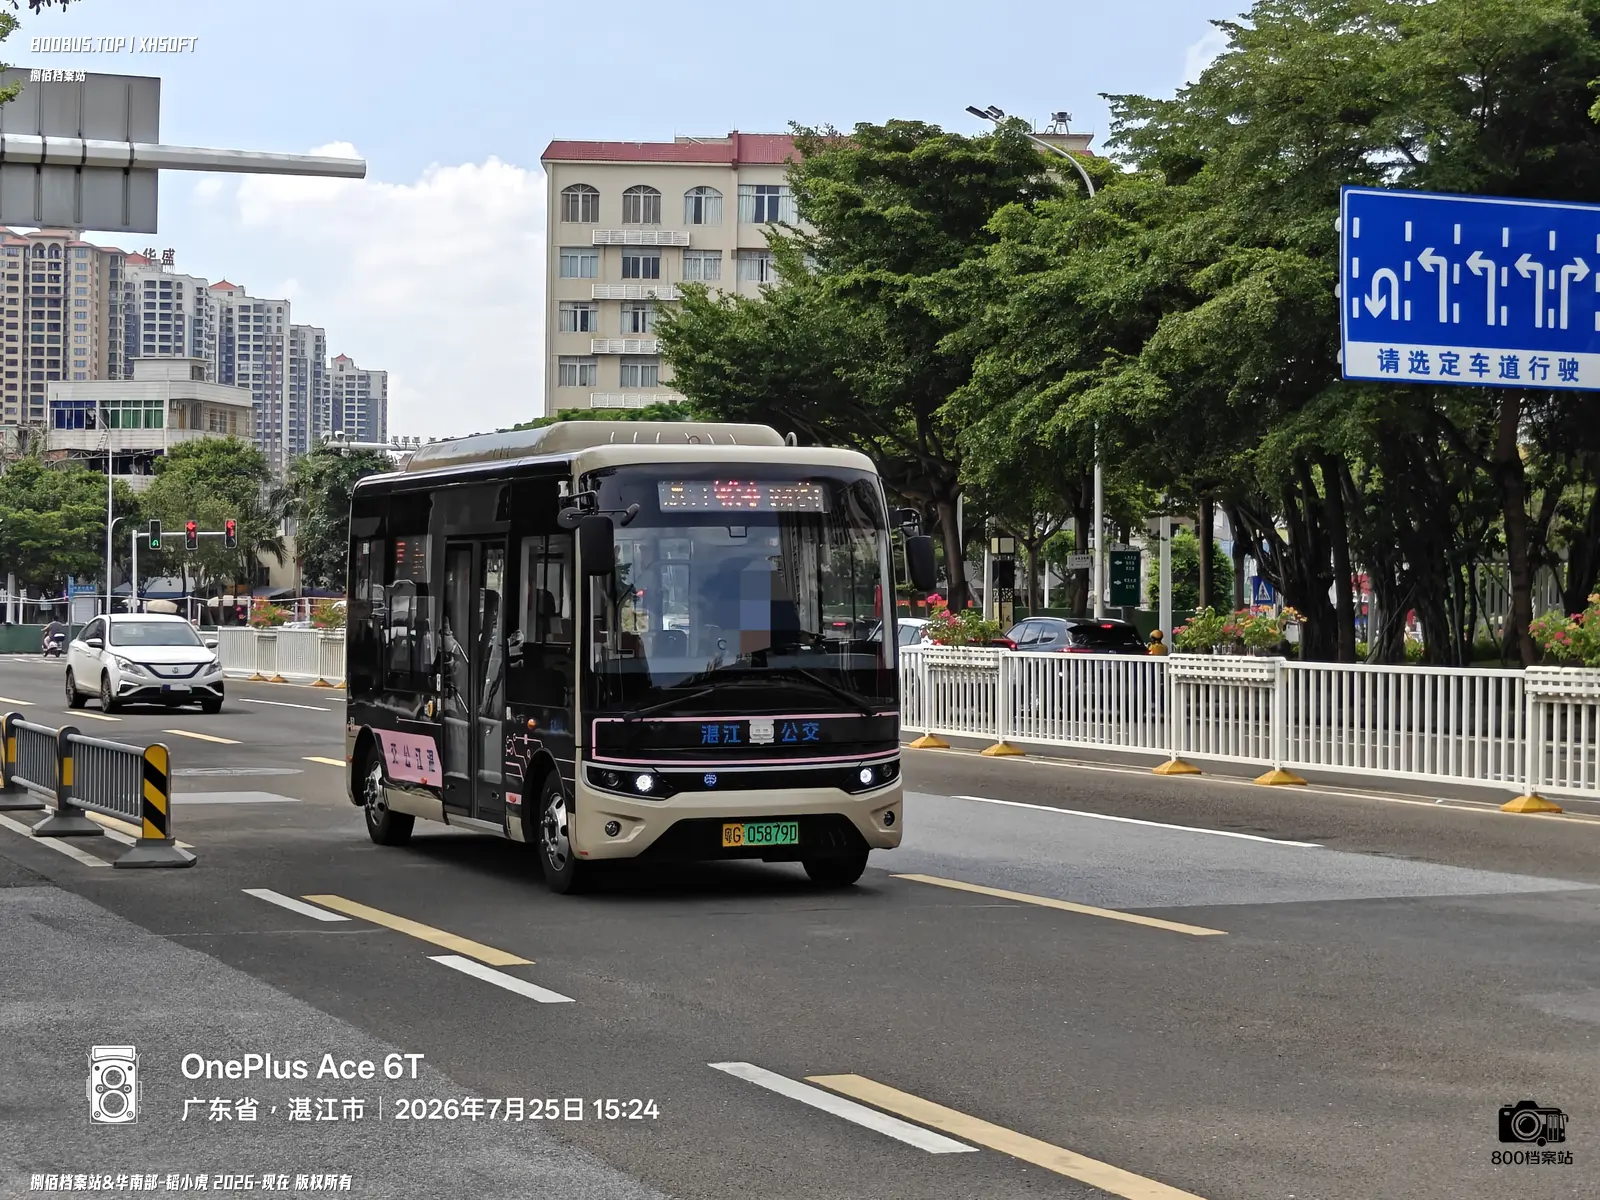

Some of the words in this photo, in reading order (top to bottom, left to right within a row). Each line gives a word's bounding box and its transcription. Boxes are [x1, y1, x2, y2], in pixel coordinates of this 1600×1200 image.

[1377, 348, 1579, 382] 请选定车道行驶
[701, 724, 741, 744] 湛江
[781, 722, 820, 742] 公交
